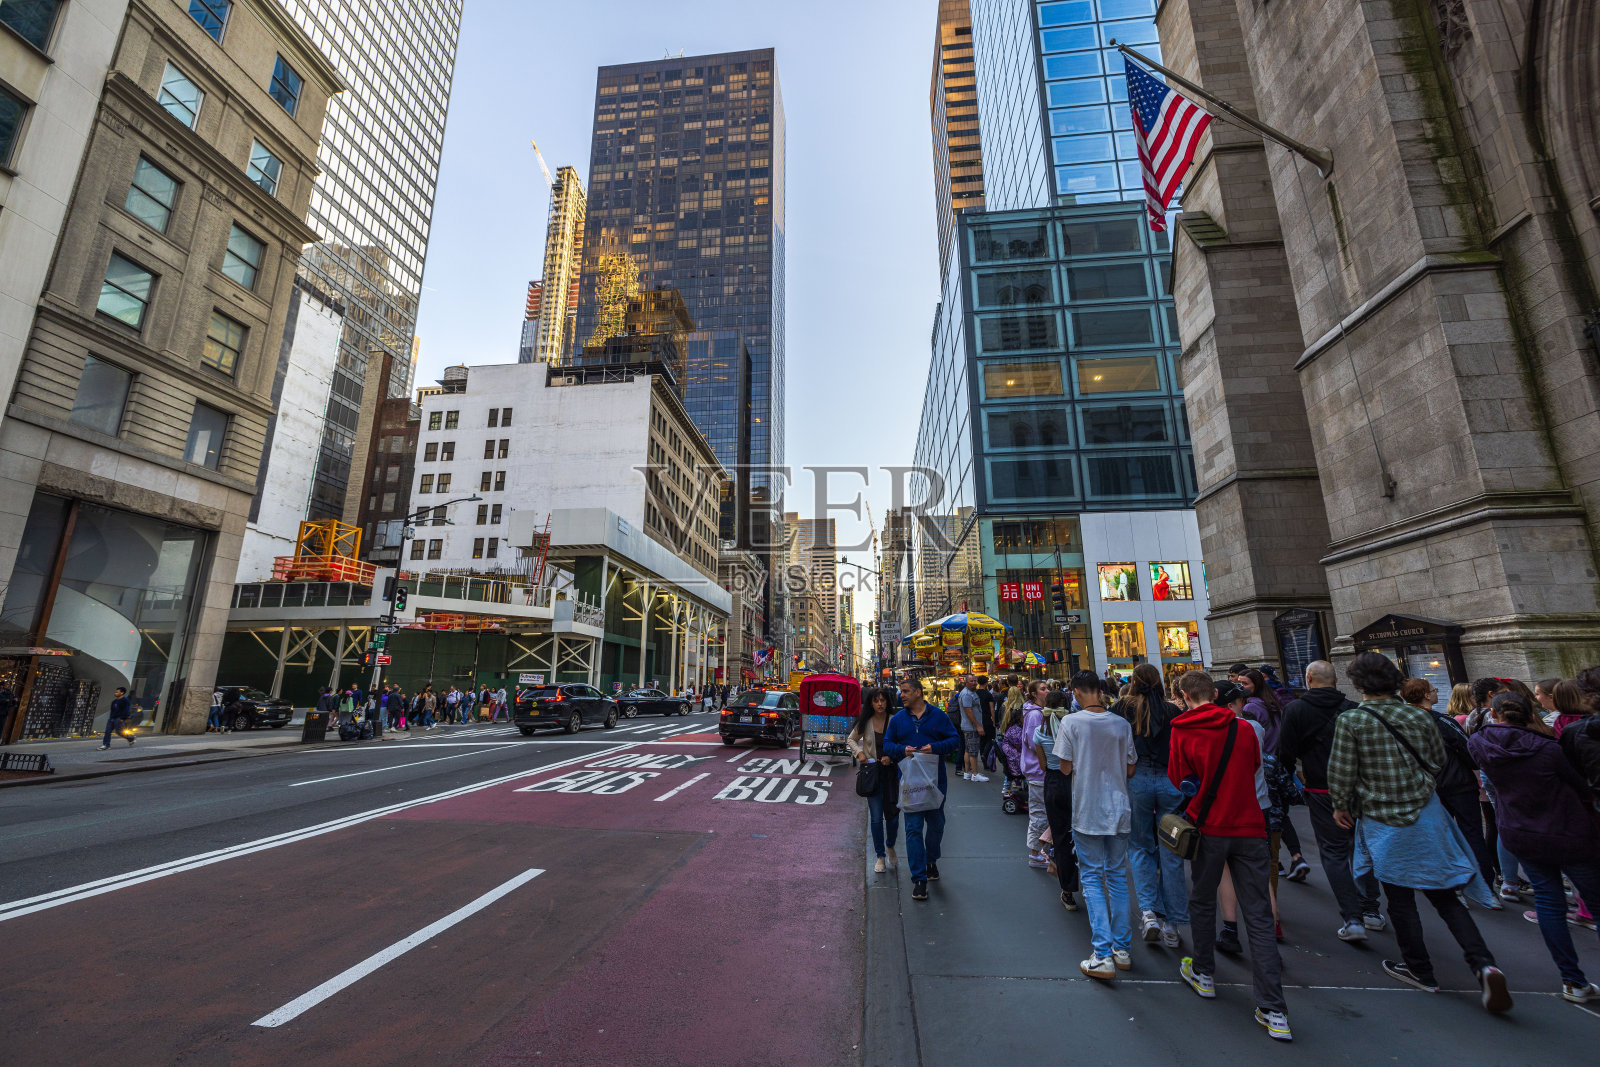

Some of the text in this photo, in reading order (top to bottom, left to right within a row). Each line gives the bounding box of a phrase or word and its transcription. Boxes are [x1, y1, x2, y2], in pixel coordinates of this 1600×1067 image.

[584, 754, 717, 769] ONLY
[736, 758, 850, 777] ONLY
[512, 770, 662, 795] BUS
[711, 775, 833, 805] BUS
